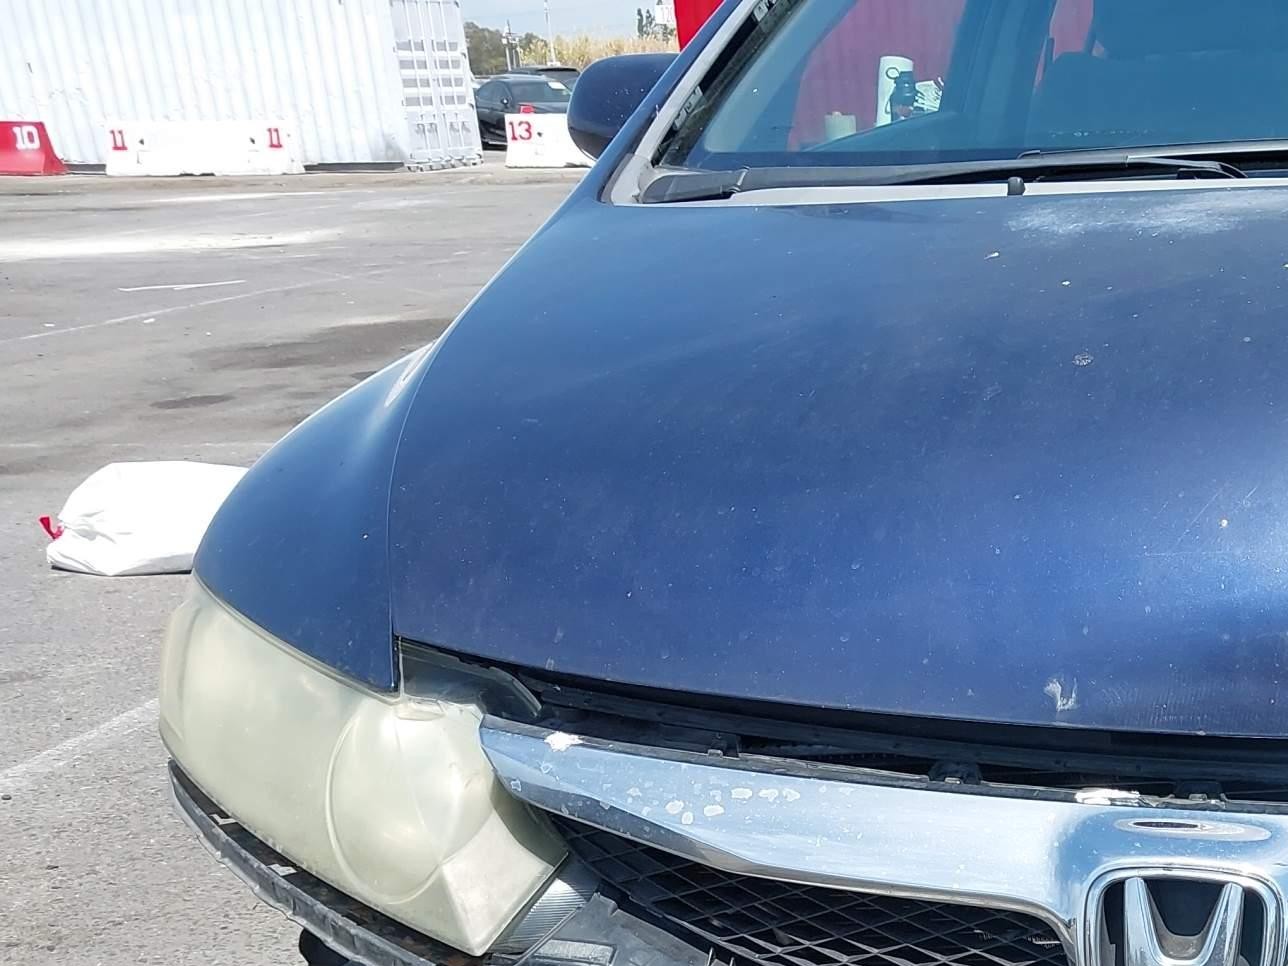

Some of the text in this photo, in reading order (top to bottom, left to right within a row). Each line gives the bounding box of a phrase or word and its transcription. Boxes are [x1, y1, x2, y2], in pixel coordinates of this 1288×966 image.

[12, 125, 41, 150] 10
[109, 129, 128, 151] 11
[267, 127, 283, 148] 11
[509, 120, 532, 141] 13
